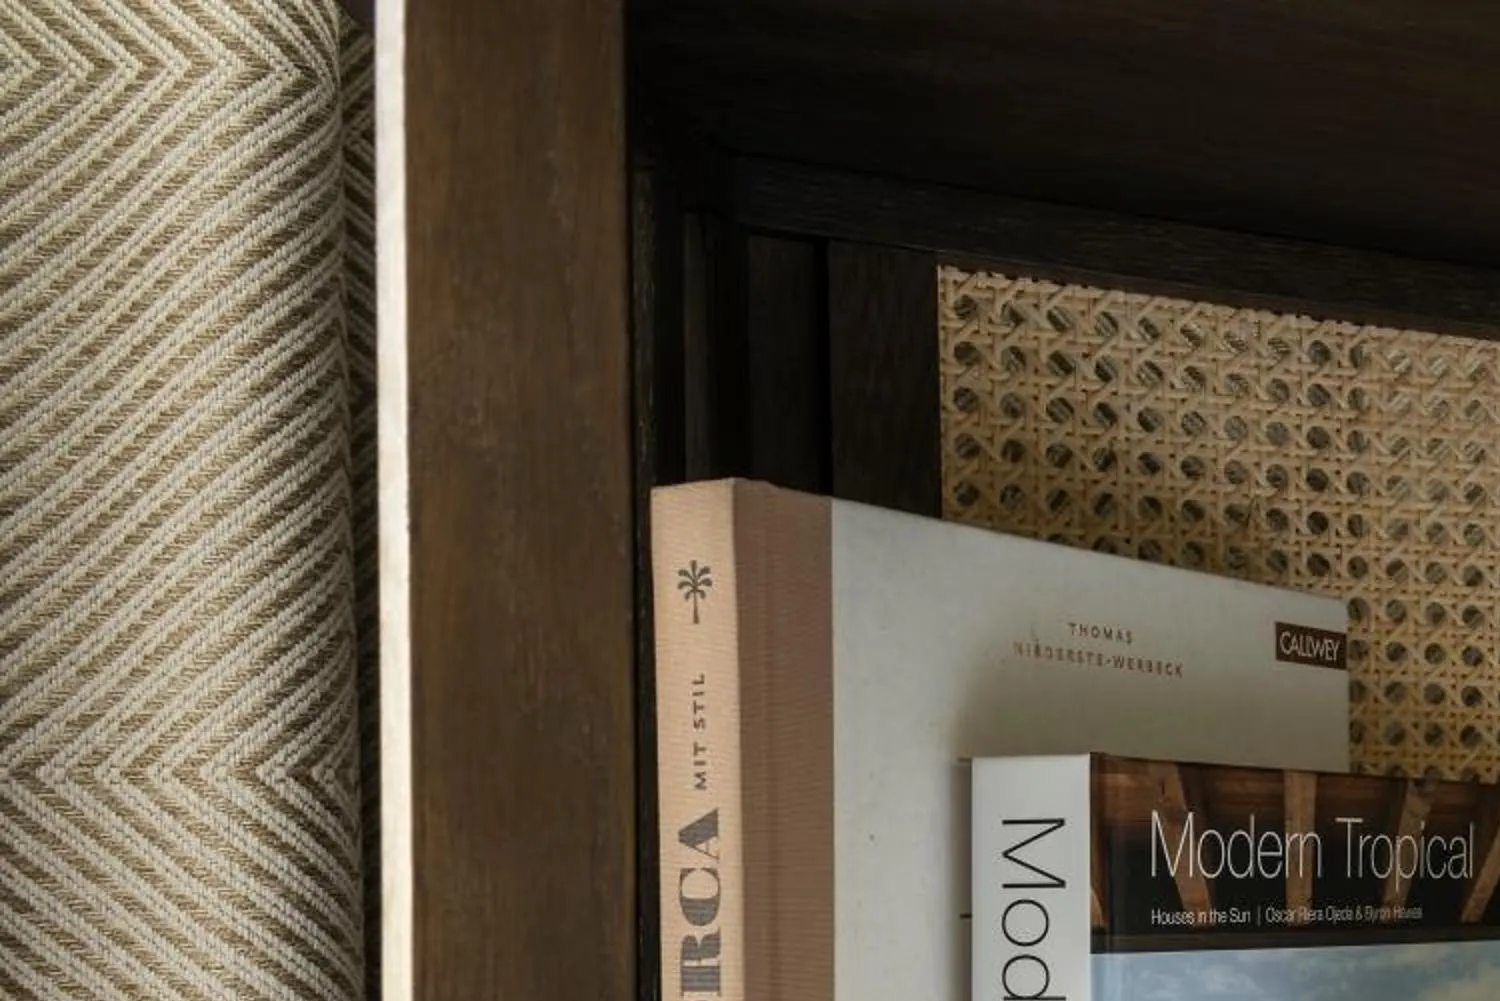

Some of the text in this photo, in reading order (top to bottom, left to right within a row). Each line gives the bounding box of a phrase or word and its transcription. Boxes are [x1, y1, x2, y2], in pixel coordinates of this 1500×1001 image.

[1066, 621, 1133, 646] THOMAS
[1279, 634, 1341, 662] CALLWEY
[693, 672, 706, 731] STIL
[693, 741, 708, 791] MIT
[1149, 807, 1476, 893] Modern Tropical
[1150, 907, 1196, 925] Houses
[1197, 908, 1207, 922] in
[1208, 907, 1227, 924] the
[1229, 906, 1251, 924] Sun
[1265, 906, 1296, 924] Oscar
